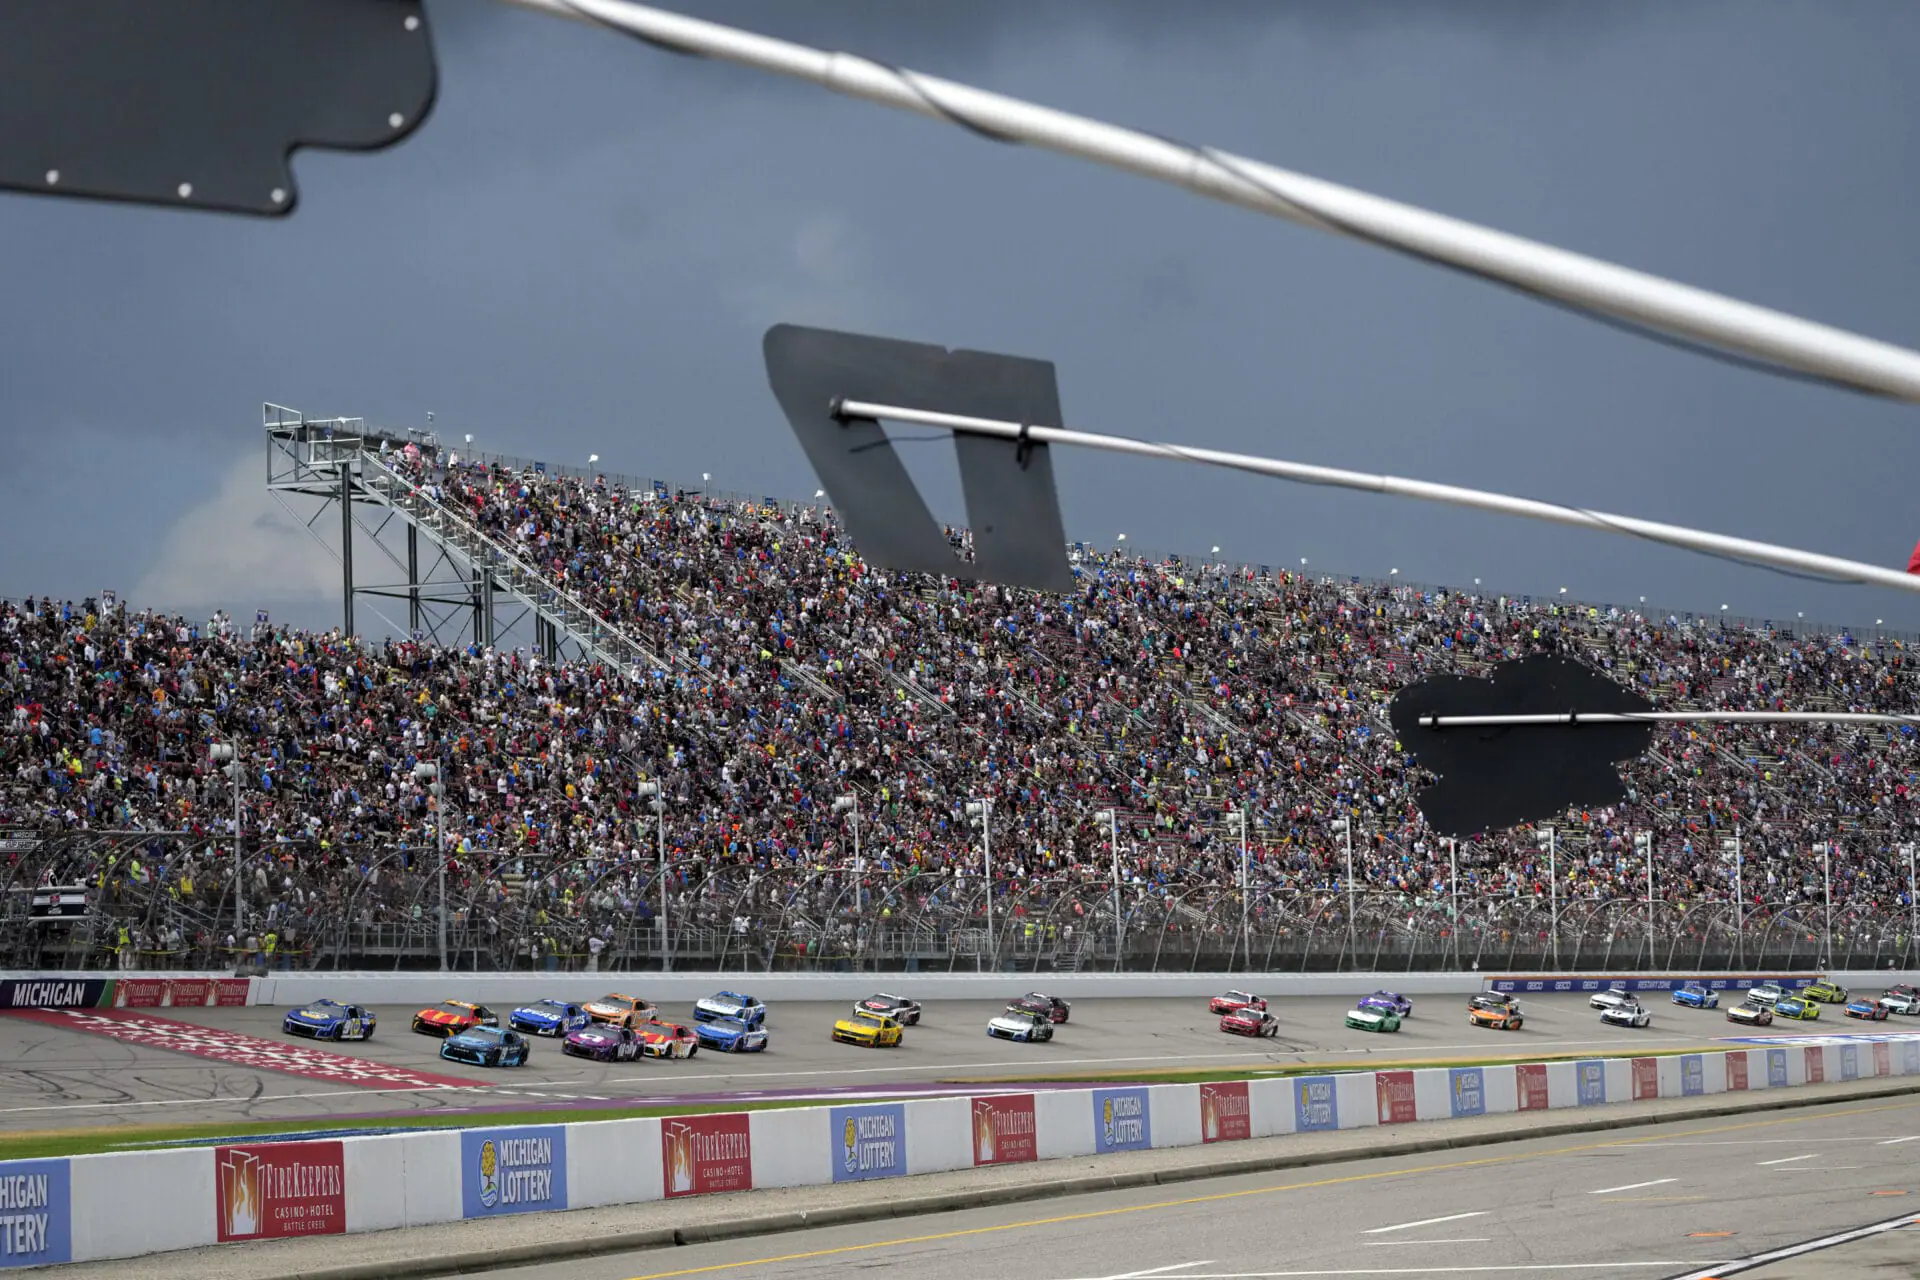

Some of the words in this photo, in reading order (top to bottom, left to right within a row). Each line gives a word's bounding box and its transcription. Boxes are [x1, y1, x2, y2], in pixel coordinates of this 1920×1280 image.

[12, 983, 85, 1006] MICHIGAN
[1113, 1096, 1142, 1117] MICHIGAN
[858, 1114, 895, 1139] MICHIGAN
[1115, 1119, 1143, 1143] LOTTERY
[500, 1138, 551, 1166] MICHIGAN
[697, 1131, 748, 1162] FIREKEEPERS
[860, 1141, 896, 1170] LOTTERY
[266, 1162, 341, 1199] FIREKEEPERS
[702, 1167, 724, 1178] CASINO
[727, 1165, 744, 1176] HOTEL
[501, 1169, 552, 1204] LOTTERY
[274, 1206, 305, 1219] CASINO
[310, 1204, 334, 1217] HOTEL
[0, 1212, 49, 1255] TERY
[283, 1221, 305, 1232] BATTLE
[307, 1219, 326, 1229] CREEK
